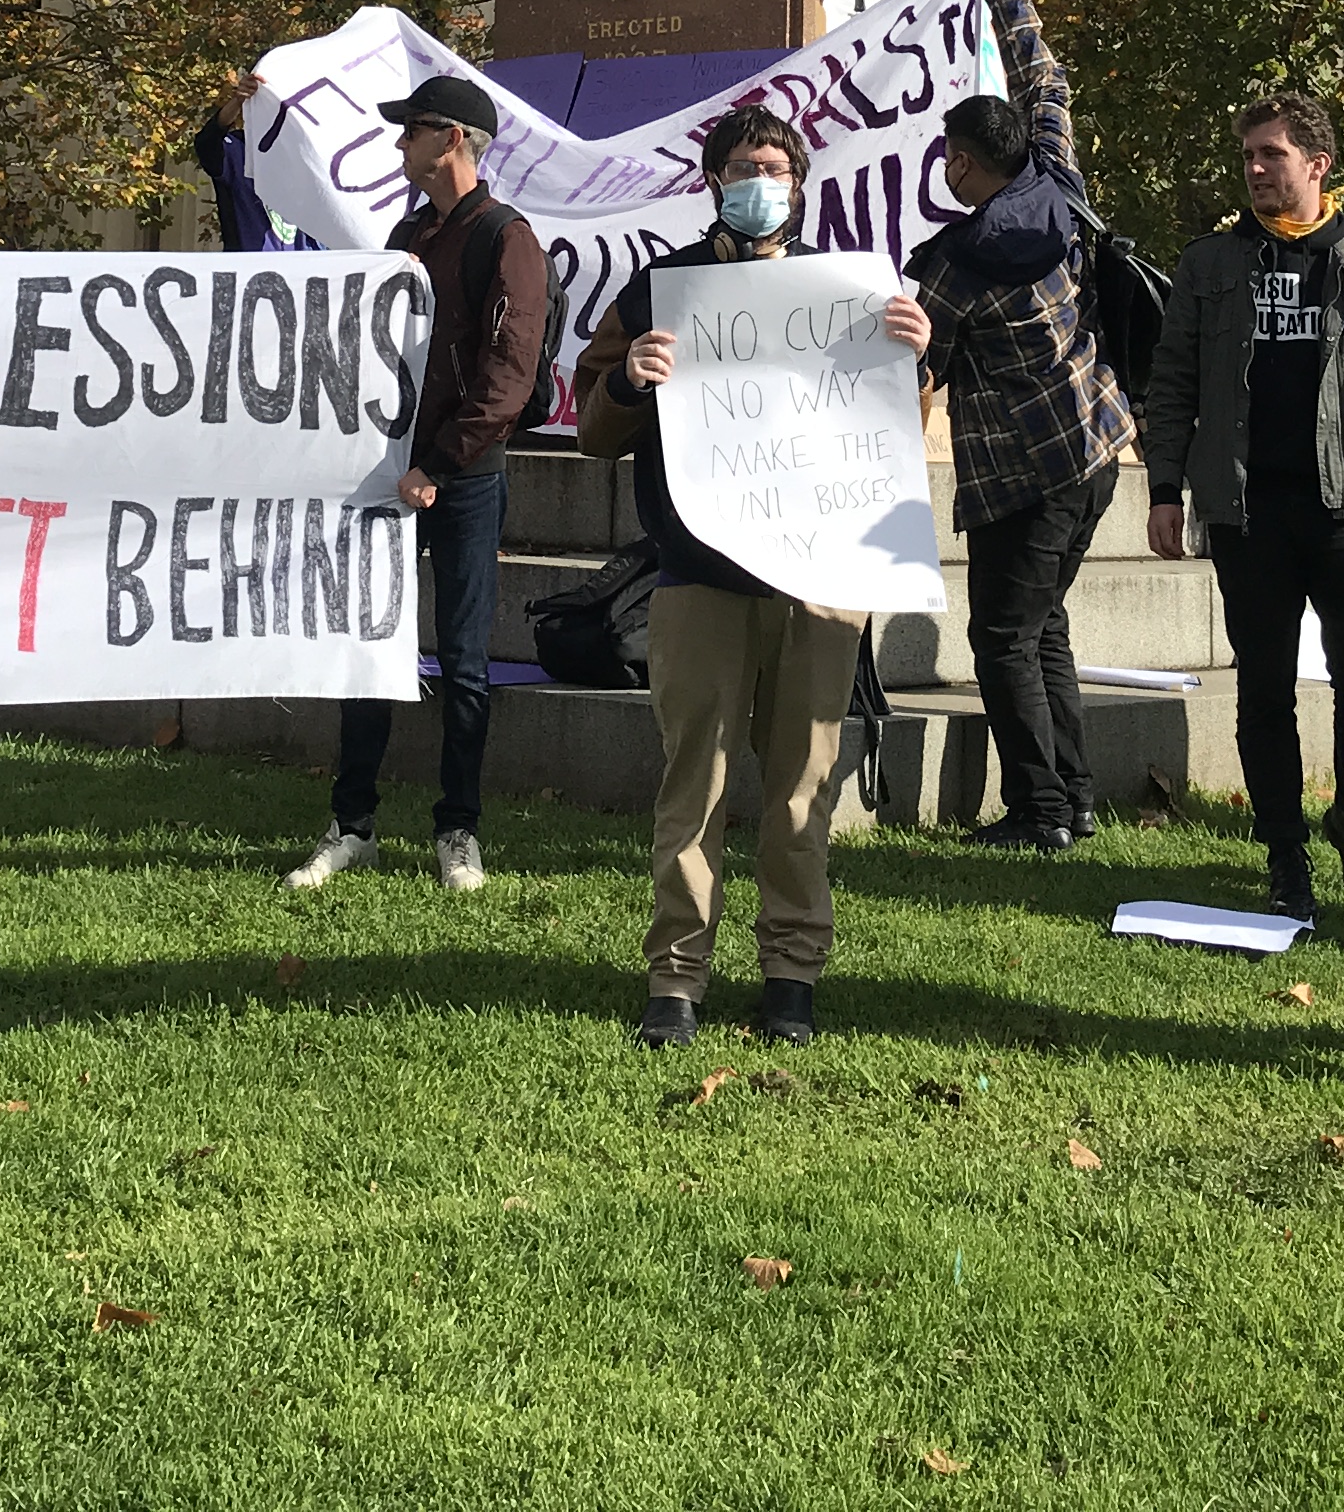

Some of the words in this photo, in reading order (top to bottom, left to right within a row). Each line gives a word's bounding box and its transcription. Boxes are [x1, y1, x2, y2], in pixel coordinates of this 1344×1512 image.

[587, 16, 683, 39] ERECTED
[693, 310, 757, 363] NO
[785, 292, 879, 353] CUTS
[701, 378, 763, 429] NO
[789, 369, 863, 415] WAY
[712, 434, 815, 479] MAKE
[834, 429, 893, 463] THE
[814, 475, 896, 516] BOSSES
[107, 496, 405, 647] BEHIND
